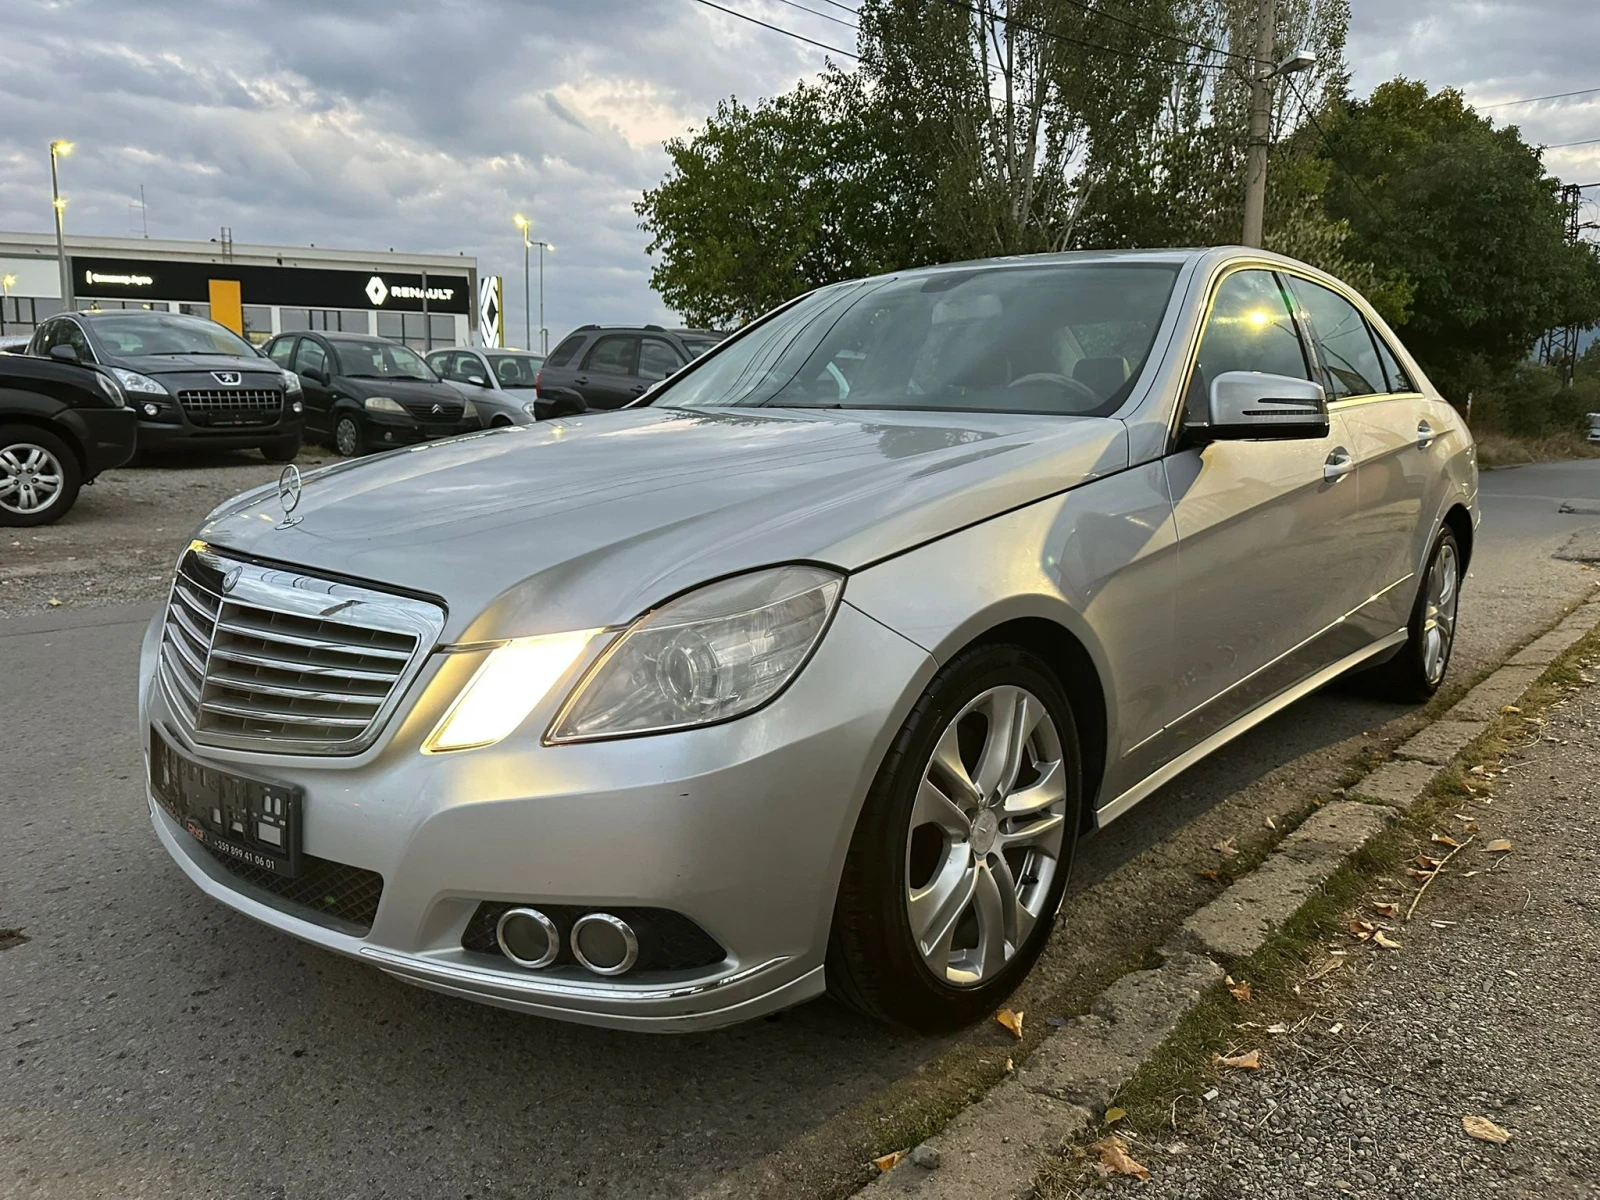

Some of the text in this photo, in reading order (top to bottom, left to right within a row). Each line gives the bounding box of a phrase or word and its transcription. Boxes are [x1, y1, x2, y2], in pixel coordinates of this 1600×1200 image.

[390, 286, 454, 300] RENAULT
[214, 840, 275, 870] +359 899 41 06 01
